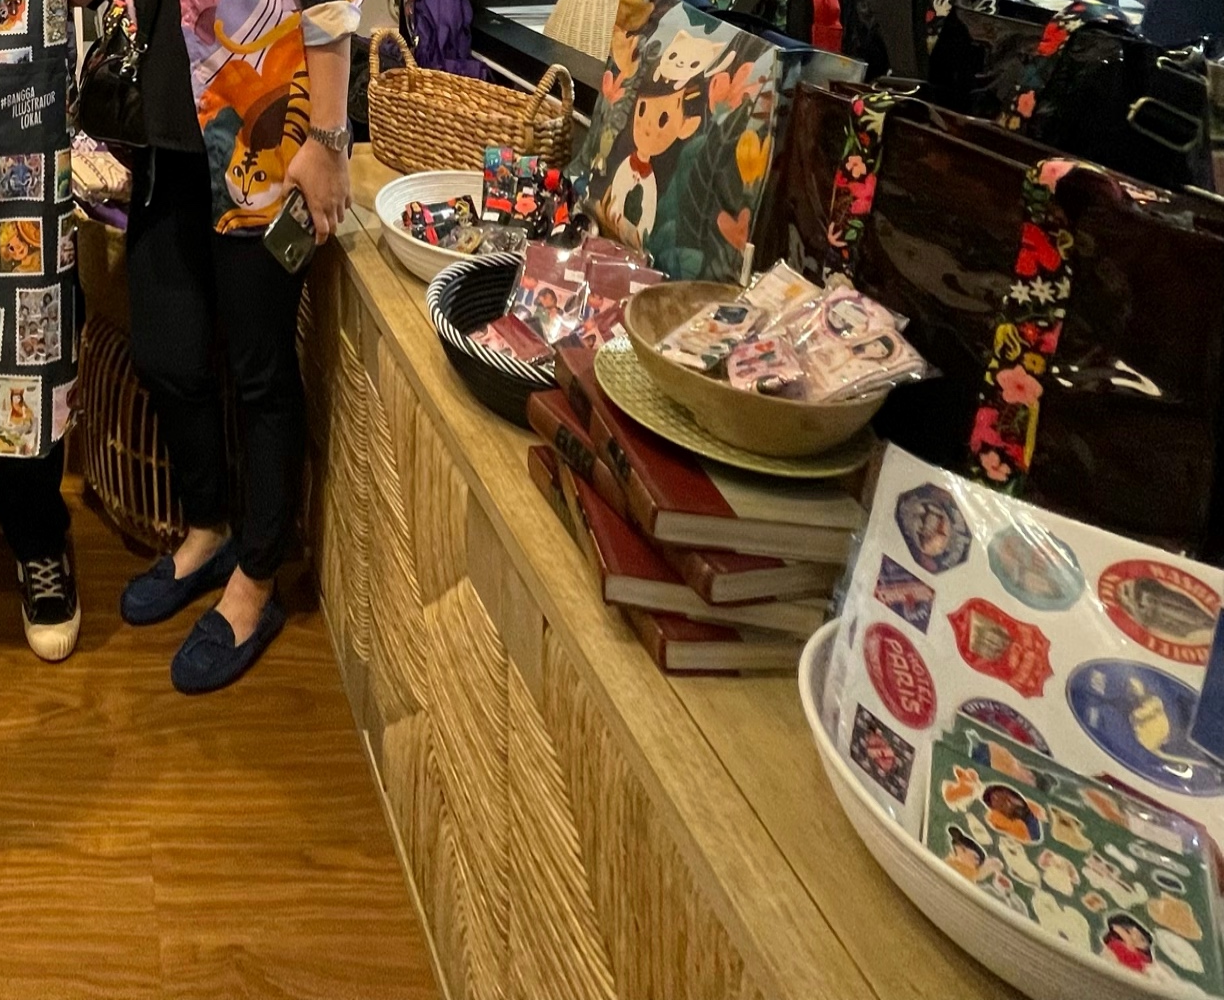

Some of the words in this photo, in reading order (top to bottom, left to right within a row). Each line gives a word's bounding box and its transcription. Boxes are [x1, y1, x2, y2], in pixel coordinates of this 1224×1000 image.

[0, 85, 35, 110] #BANGGA
[12, 90, 56, 118] ILLUSTRATOR
[20, 110, 42, 130] LOKAL
[883, 637, 922, 716] PARIS
